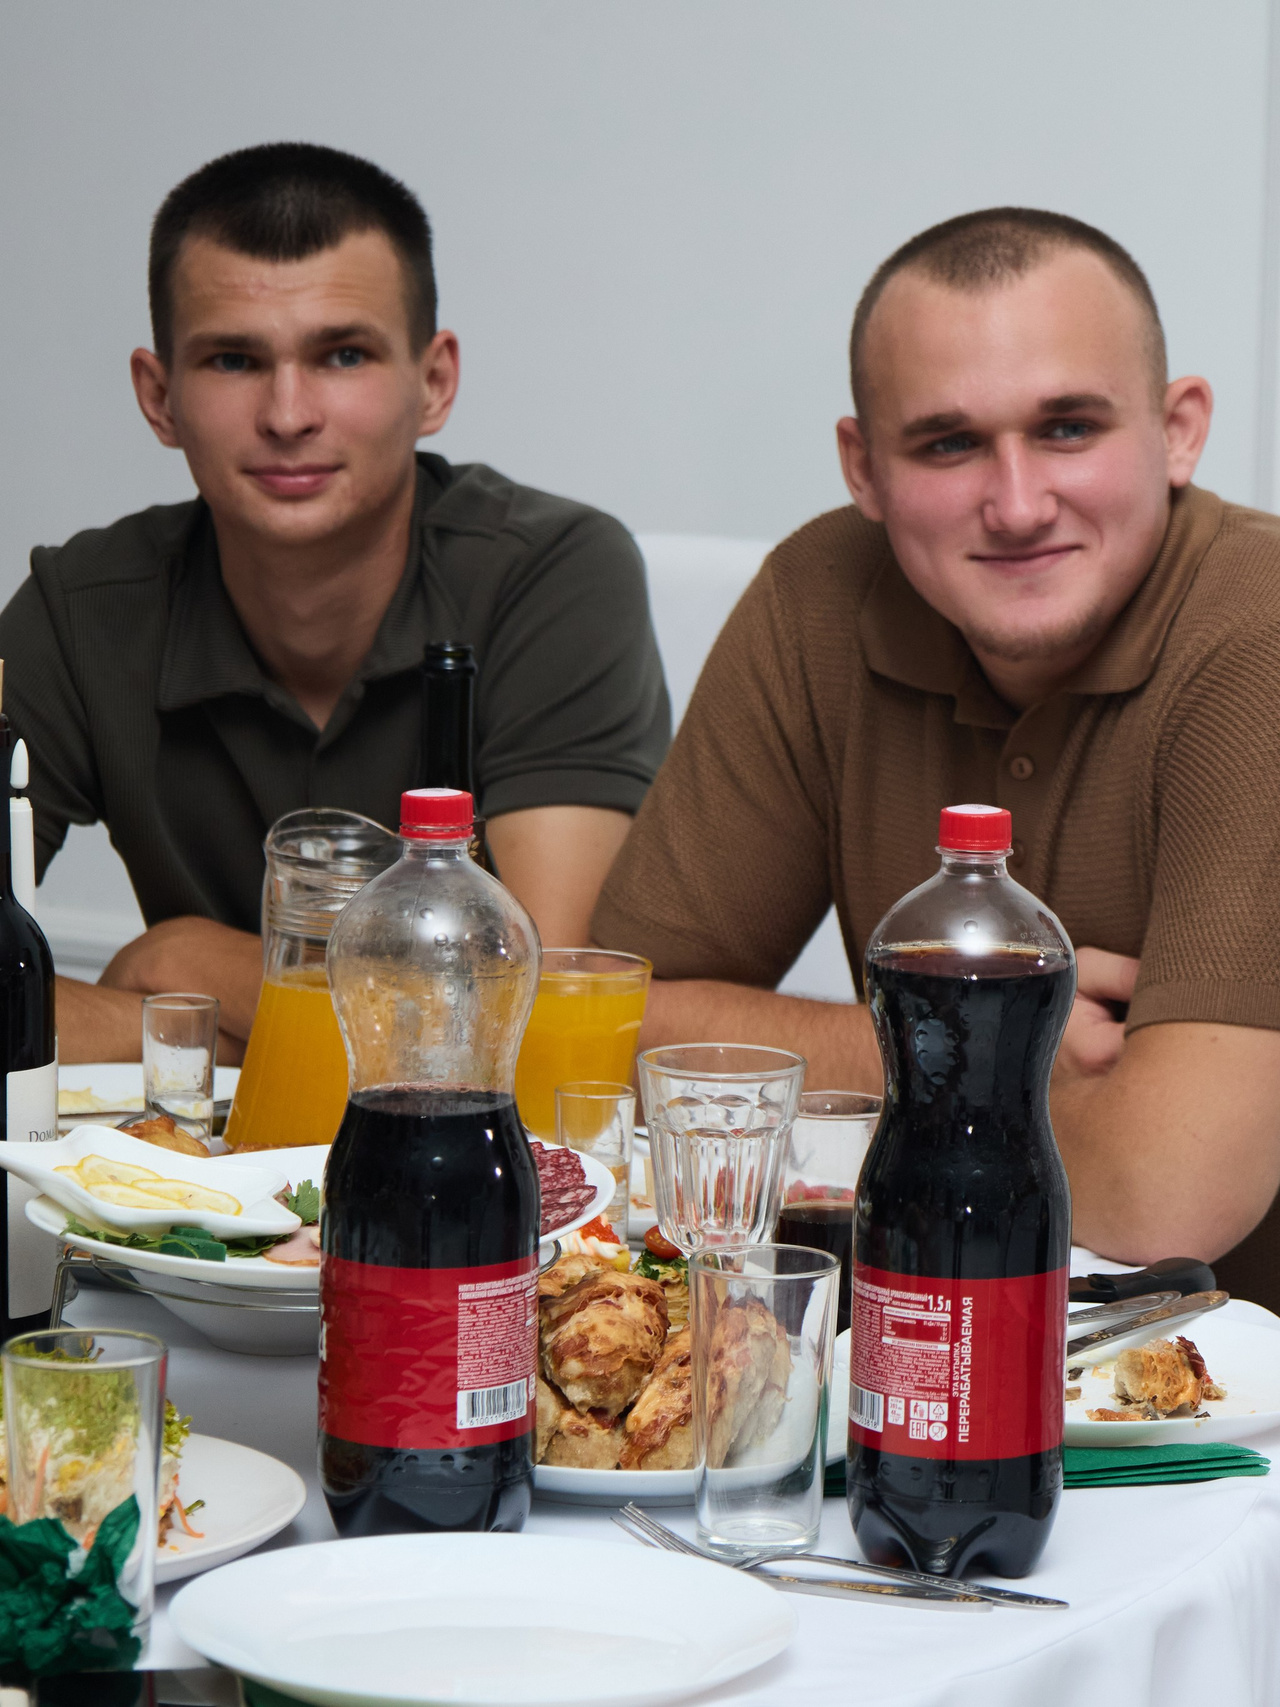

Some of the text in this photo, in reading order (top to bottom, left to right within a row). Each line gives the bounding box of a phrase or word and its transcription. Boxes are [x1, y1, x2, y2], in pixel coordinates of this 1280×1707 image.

[928, 1294, 944, 1313] 1,5
[952, 1341, 961, 1398] ЭТА БУТЫЛКА
[958, 1296, 974, 1443] ПЕРЕРАБАТЫВАЕМАЯ
